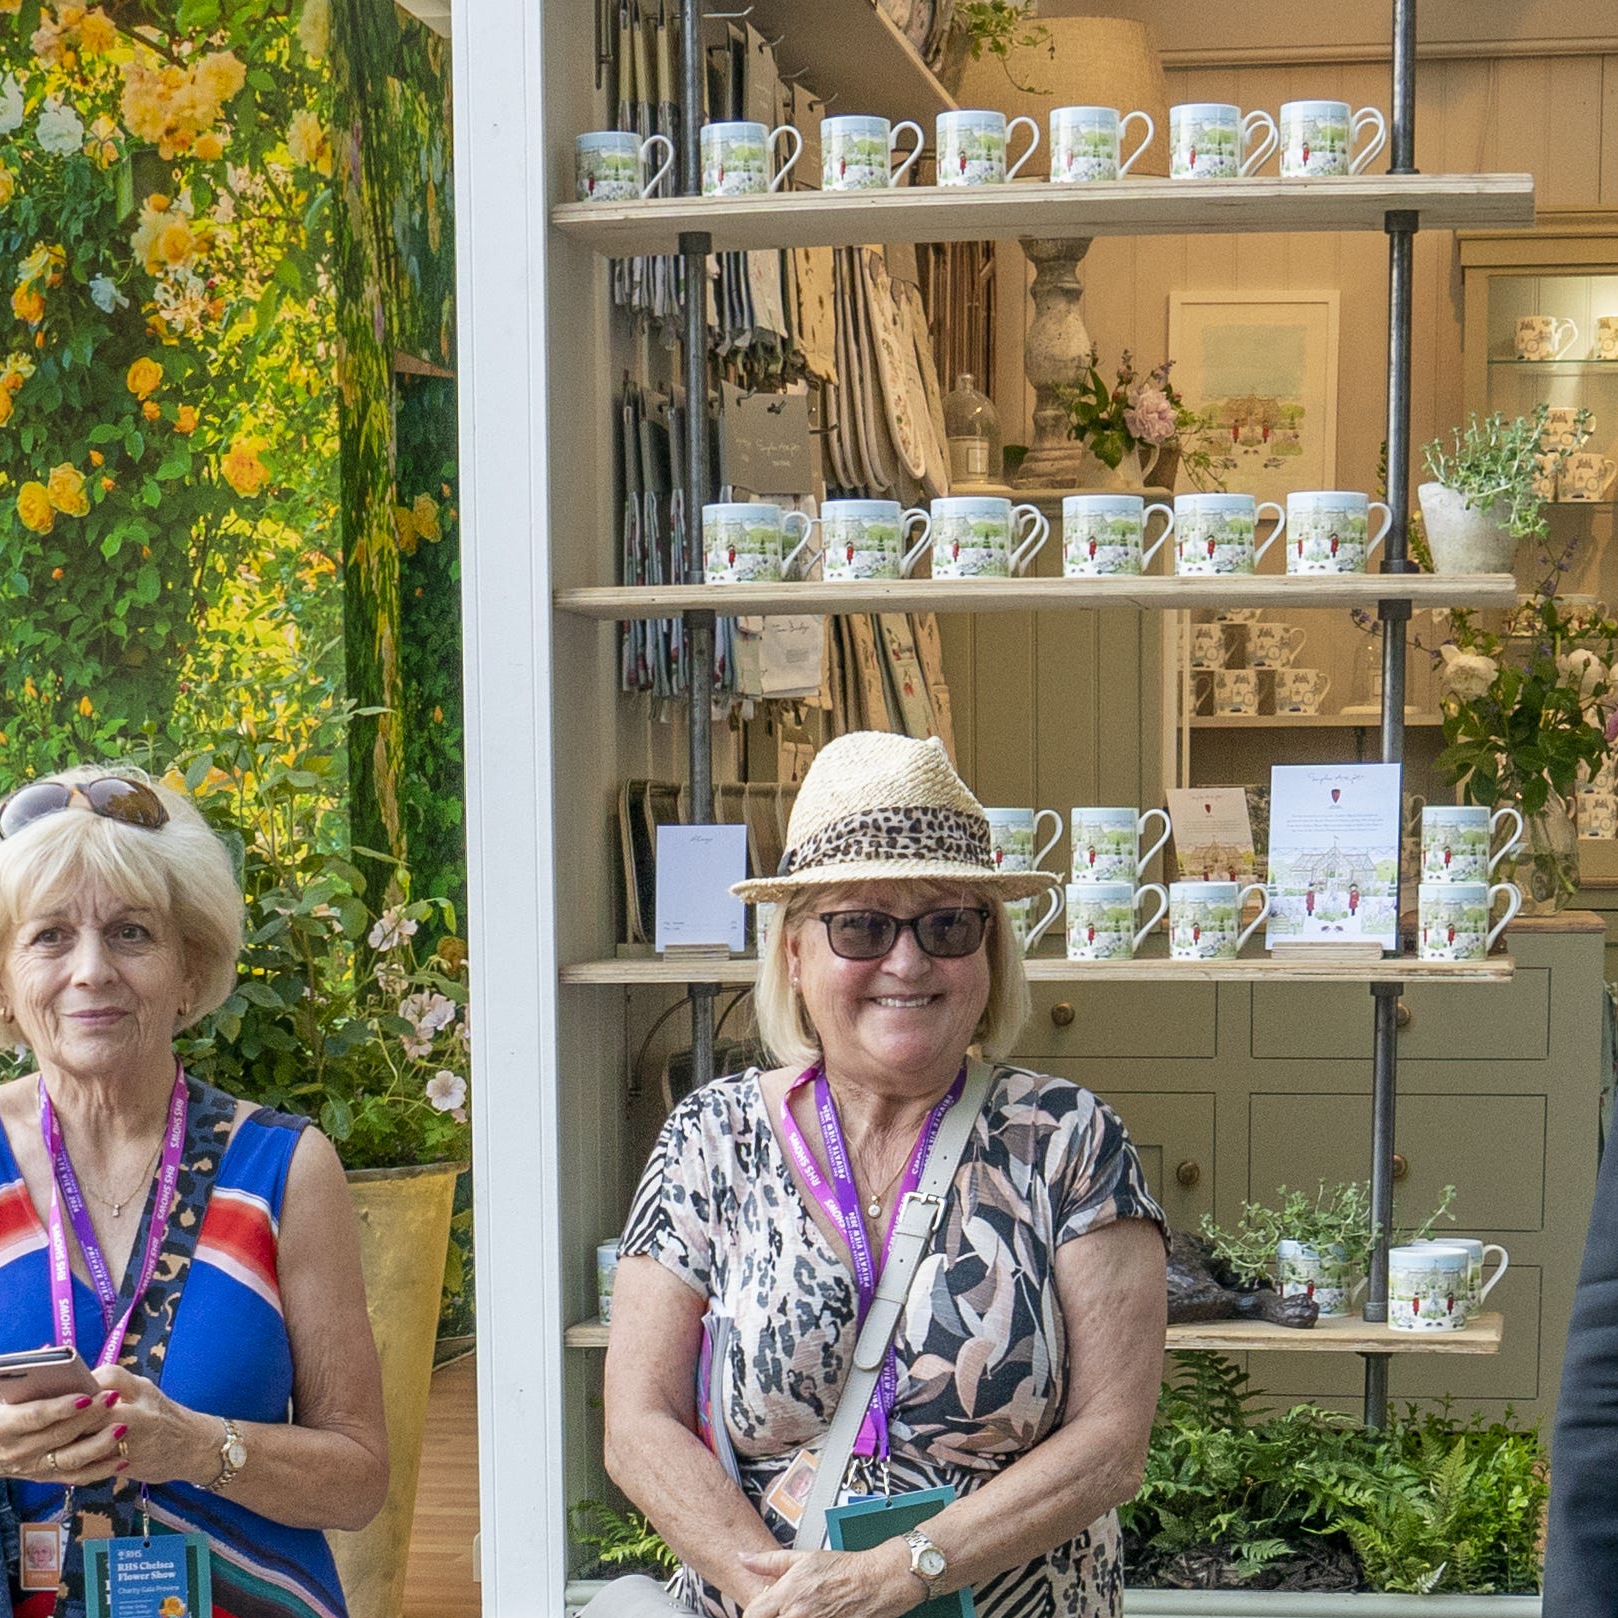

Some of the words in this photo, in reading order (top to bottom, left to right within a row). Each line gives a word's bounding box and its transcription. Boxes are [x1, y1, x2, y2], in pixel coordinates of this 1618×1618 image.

[173, 1097, 187, 1117] RHS
[931, 1092, 954, 1130] PRIVATE
[168, 1115, 185, 1149] SHOWS
[825, 1121, 837, 1144] VIEW
[924, 1128, 939, 1153] VIEW
[788, 1131, 812, 1168] SHOWS
[831, 1143, 846, 1179] PRIVATE
[59, 1170, 74, 1194] VIEW
[162, 1163, 176, 1184] RHS
[802, 1159, 821, 1187] RHS
[155, 1183, 172, 1221] SHOWS
[847, 1210, 858, 1228] 2024
[51, 1221, 65, 1261] SHOWS
[148, 1235, 161, 1258] RHS
[851, 1227, 863, 1250] VIEW
[54, 1260, 66, 1281] RHS
[84, 1244, 103, 1278] PRIVATE
[97, 1277, 111, 1302] VIEW
[856, 1250, 871, 1288] PRIVATE
[58, 1297, 72, 1337] SHOWS
[880, 1364, 894, 1390] VIEW
[118, 1562, 138, 1572] RHS
[139, 1560, 174, 1570] Chelsea
[126, 1550, 142, 1558] RHS
[118, 1572, 150, 1582] Flower
[151, 1570, 176, 1580] Show
[117, 1586, 141, 1595] Charity
[156, 1584, 180, 1592] Preview
